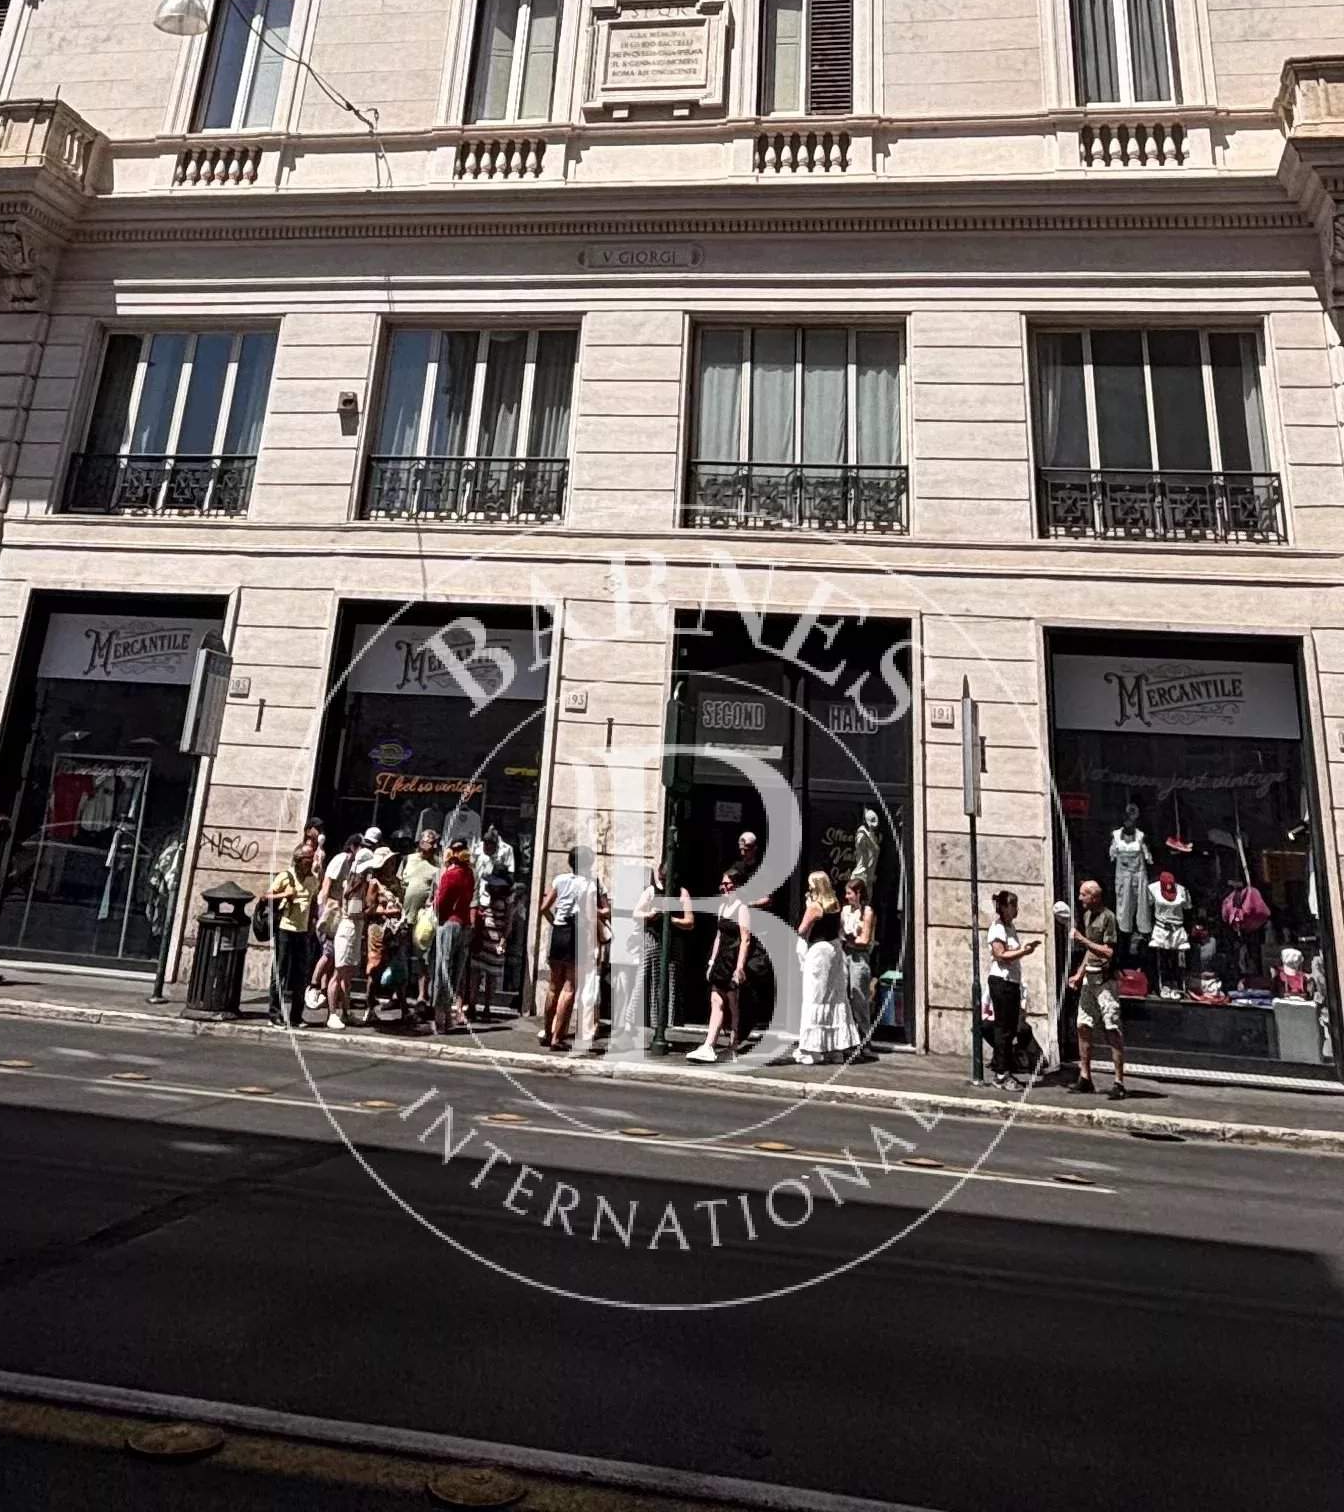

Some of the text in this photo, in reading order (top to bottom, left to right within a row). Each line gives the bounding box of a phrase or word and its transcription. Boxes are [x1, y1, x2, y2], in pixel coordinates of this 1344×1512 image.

[618, 250, 676, 265] GIORGI
[82, 628, 192, 676] MERCANTILE
[1103, 671, 1244, 727] MERCANTILE
[702, 700, 879, 734] SECOND HAND
[390, 777, 418, 800] feel
[418, 782, 433, 792] so
[434, 780, 484, 802] vintage
